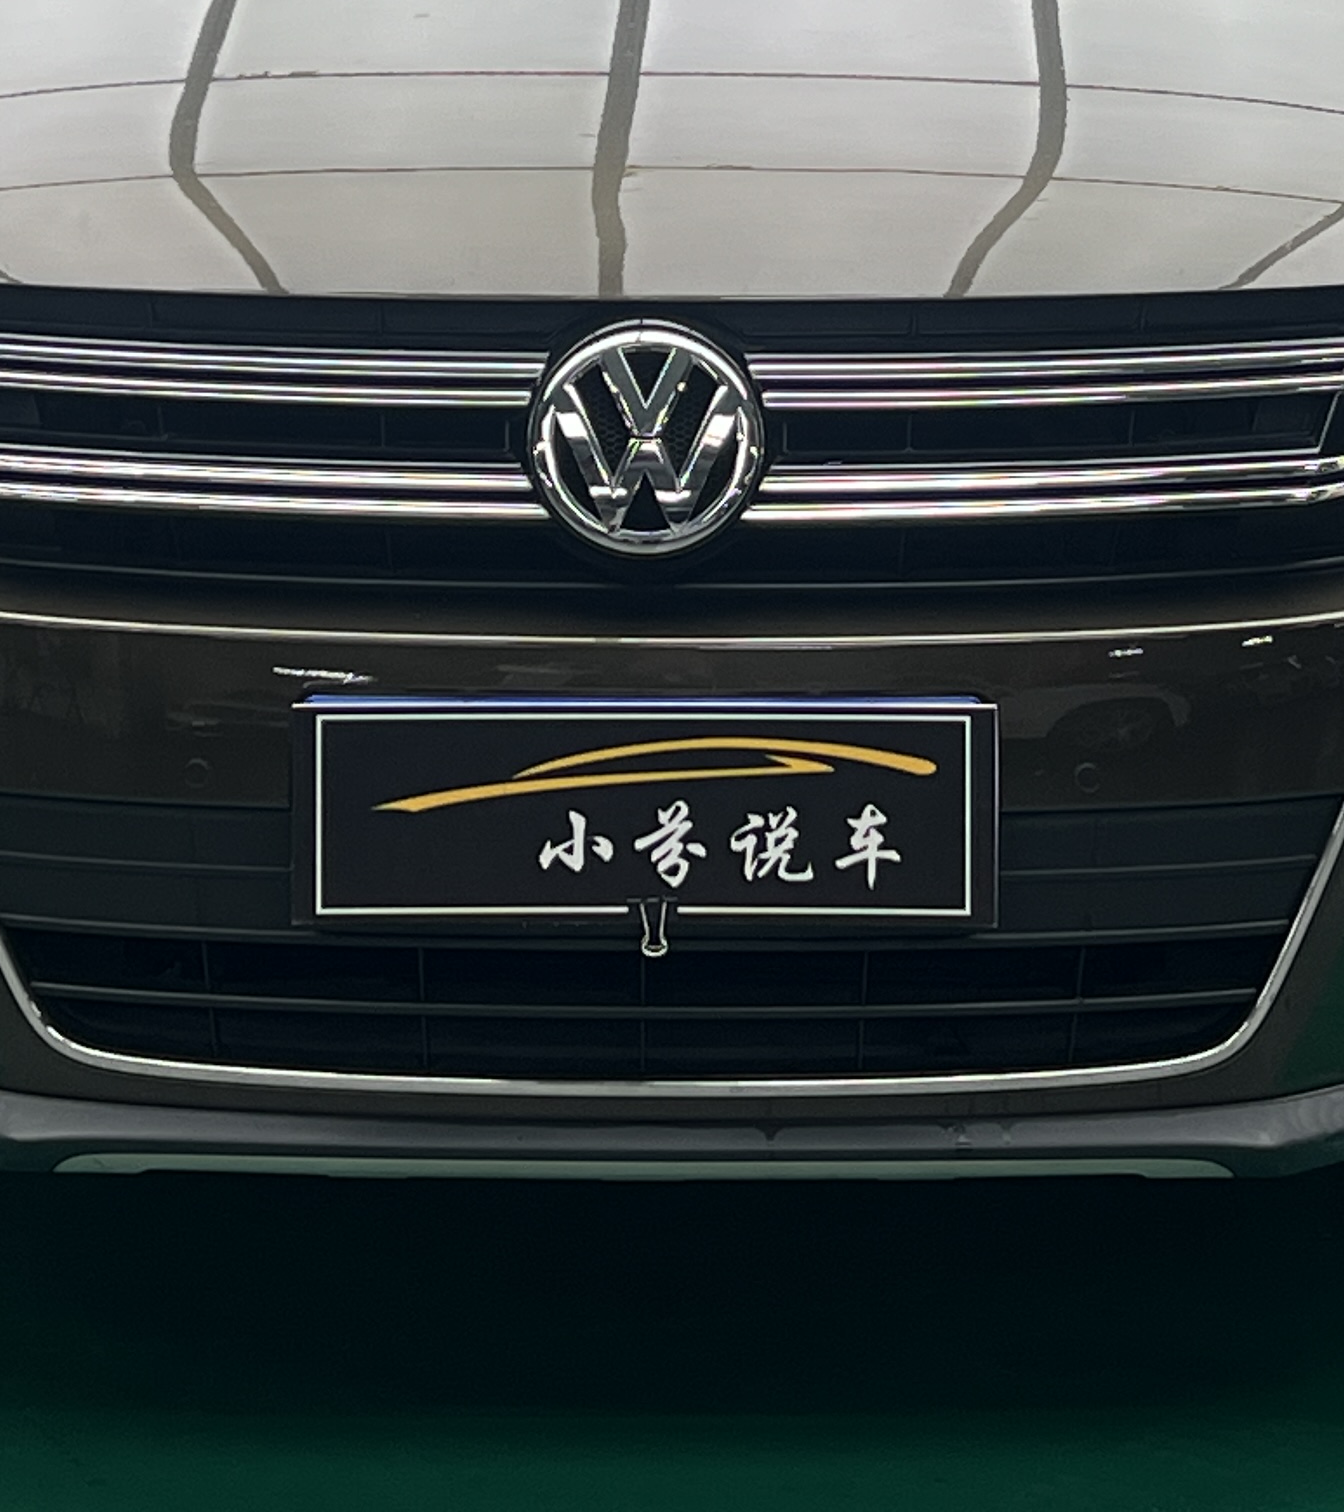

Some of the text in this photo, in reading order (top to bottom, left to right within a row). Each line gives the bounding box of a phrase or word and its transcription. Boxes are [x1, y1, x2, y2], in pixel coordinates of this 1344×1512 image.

[554, 341, 743, 537] VW
[538, 800, 901, 889] 小芬说车
